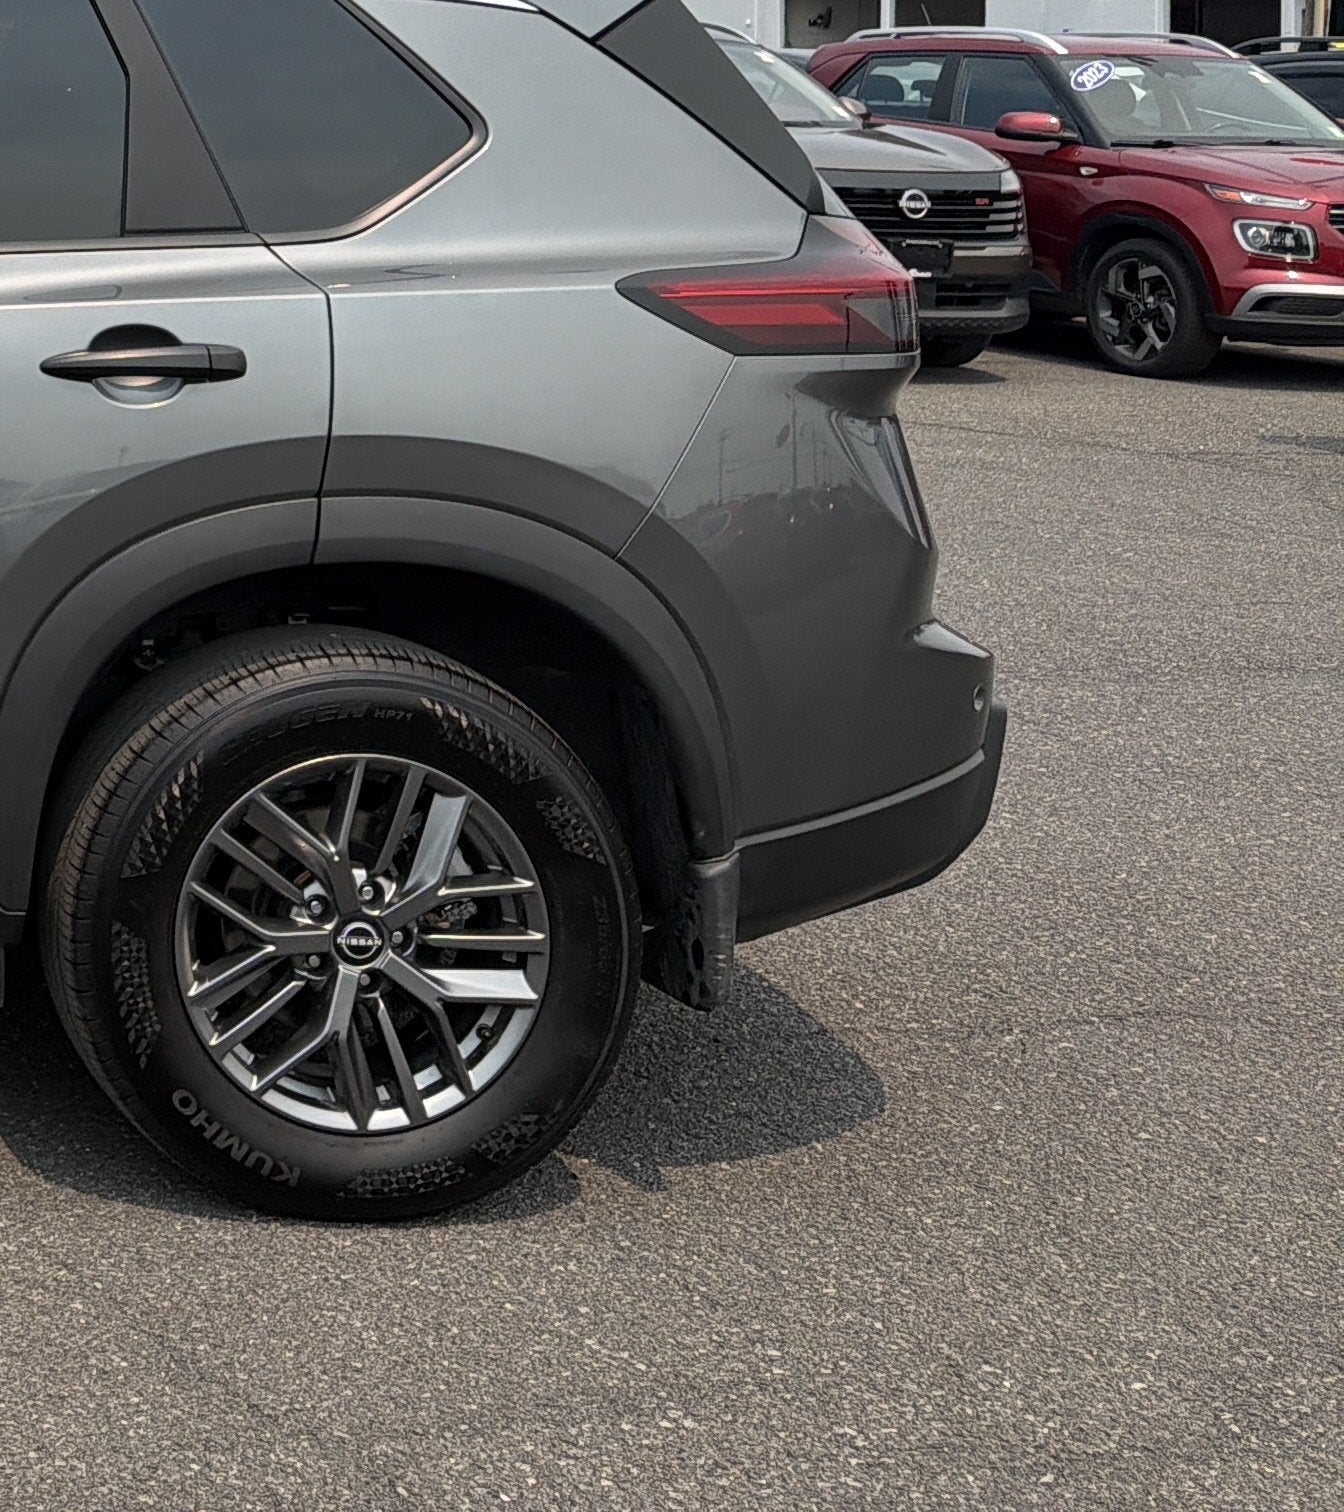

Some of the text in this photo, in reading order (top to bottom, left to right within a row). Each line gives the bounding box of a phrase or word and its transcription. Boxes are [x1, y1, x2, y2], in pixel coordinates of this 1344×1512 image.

[1077, 62, 1109, 89] 2023
[373, 707, 413, 722] HP71
[172, 1089, 301, 1188] KUMHO
